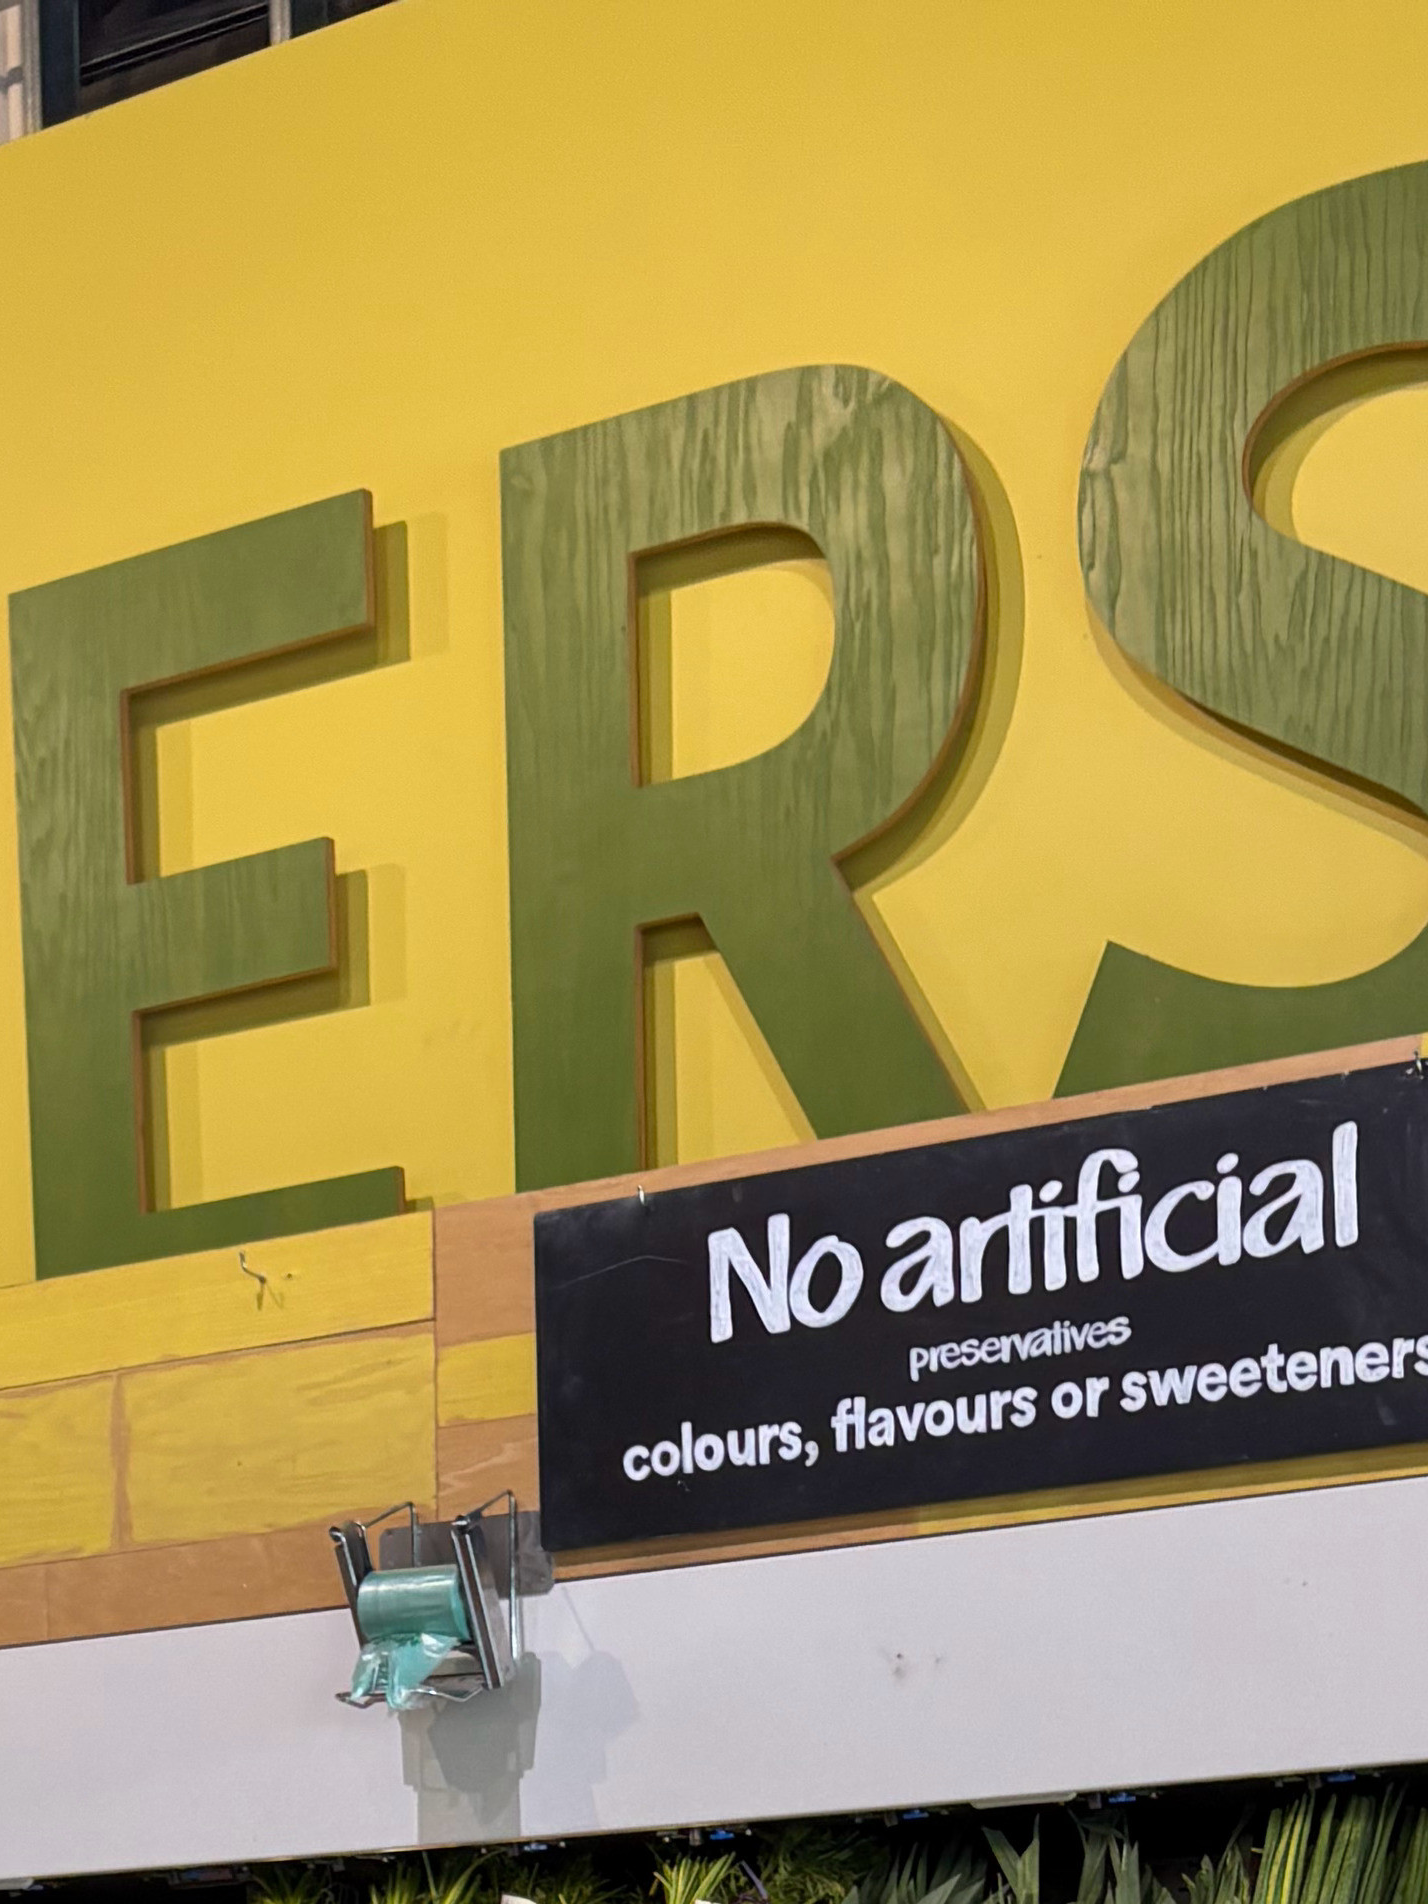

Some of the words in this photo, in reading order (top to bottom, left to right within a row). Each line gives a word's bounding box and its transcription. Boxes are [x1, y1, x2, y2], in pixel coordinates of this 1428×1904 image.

[708, 1213, 863, 1342] No
[880, 1121, 1358, 1313] artificial
[909, 1315, 1132, 1381] preservatives
[622, 1421, 819, 1481] colours,
[831, 1385, 1036, 1454] flavours
[1050, 1375, 1109, 1421] or
